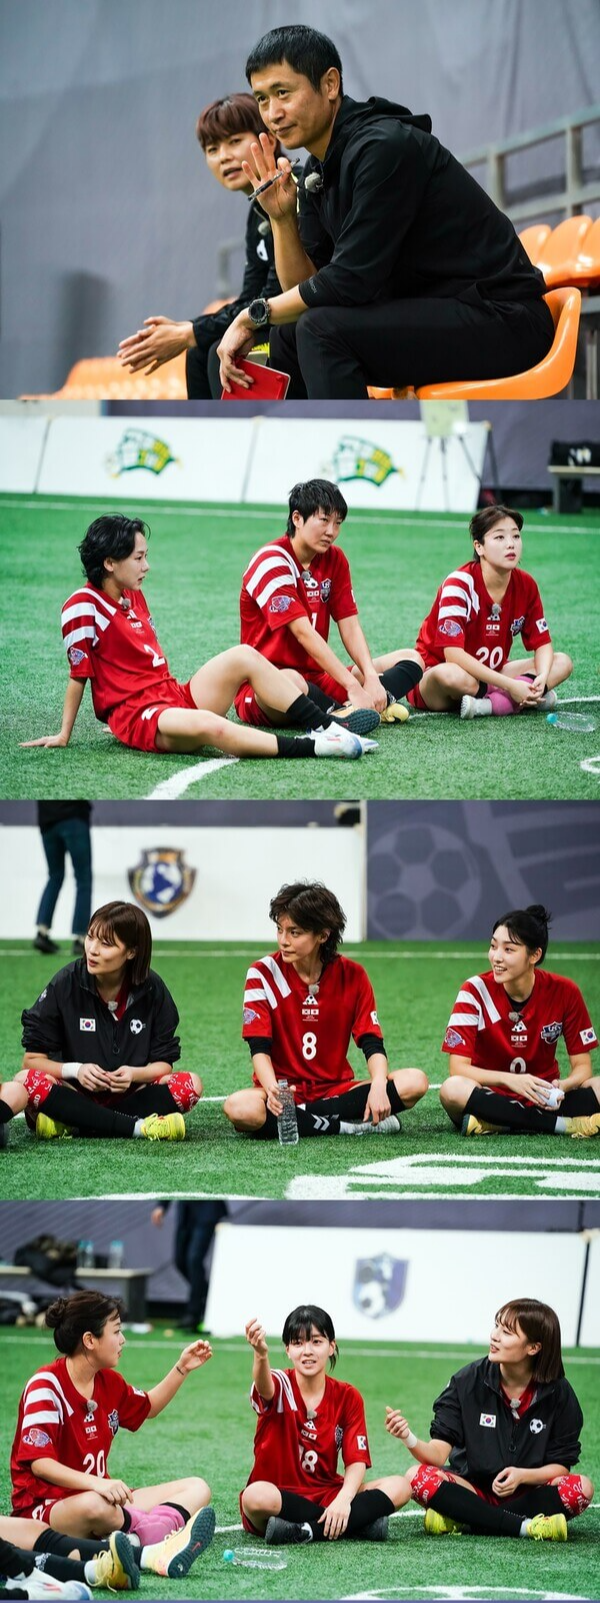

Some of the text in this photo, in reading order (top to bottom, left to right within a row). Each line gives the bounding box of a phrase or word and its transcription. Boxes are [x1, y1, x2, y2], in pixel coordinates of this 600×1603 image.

[143, 644, 166, 668] 2
[475, 646, 504, 670] 20
[302, 1031, 318, 1060] 8
[83, 1449, 105, 1479] 20
